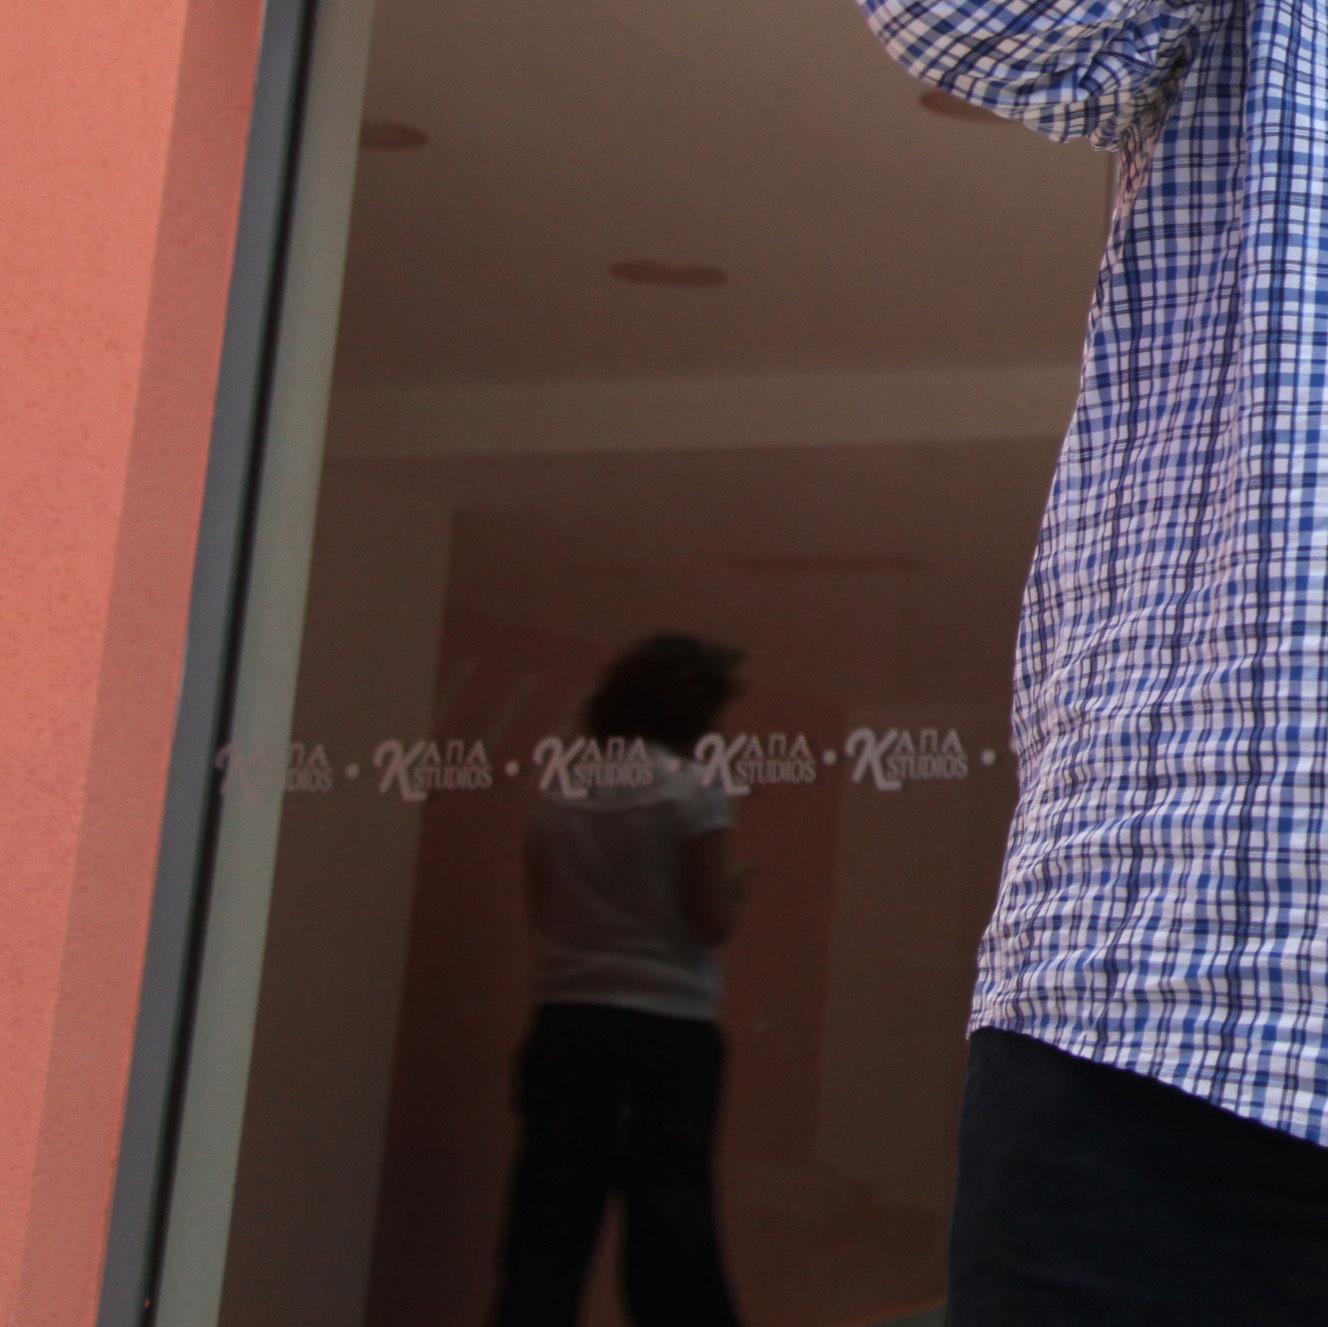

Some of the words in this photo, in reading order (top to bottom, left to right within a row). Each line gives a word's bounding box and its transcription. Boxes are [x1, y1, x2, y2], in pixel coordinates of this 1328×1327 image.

[413, 765, 493, 792] STUDIOS
[573, 761, 654, 787] STUDIOS
[735, 757, 816, 784] STUDIOS
[886, 753, 968, 780] STUDIOS
